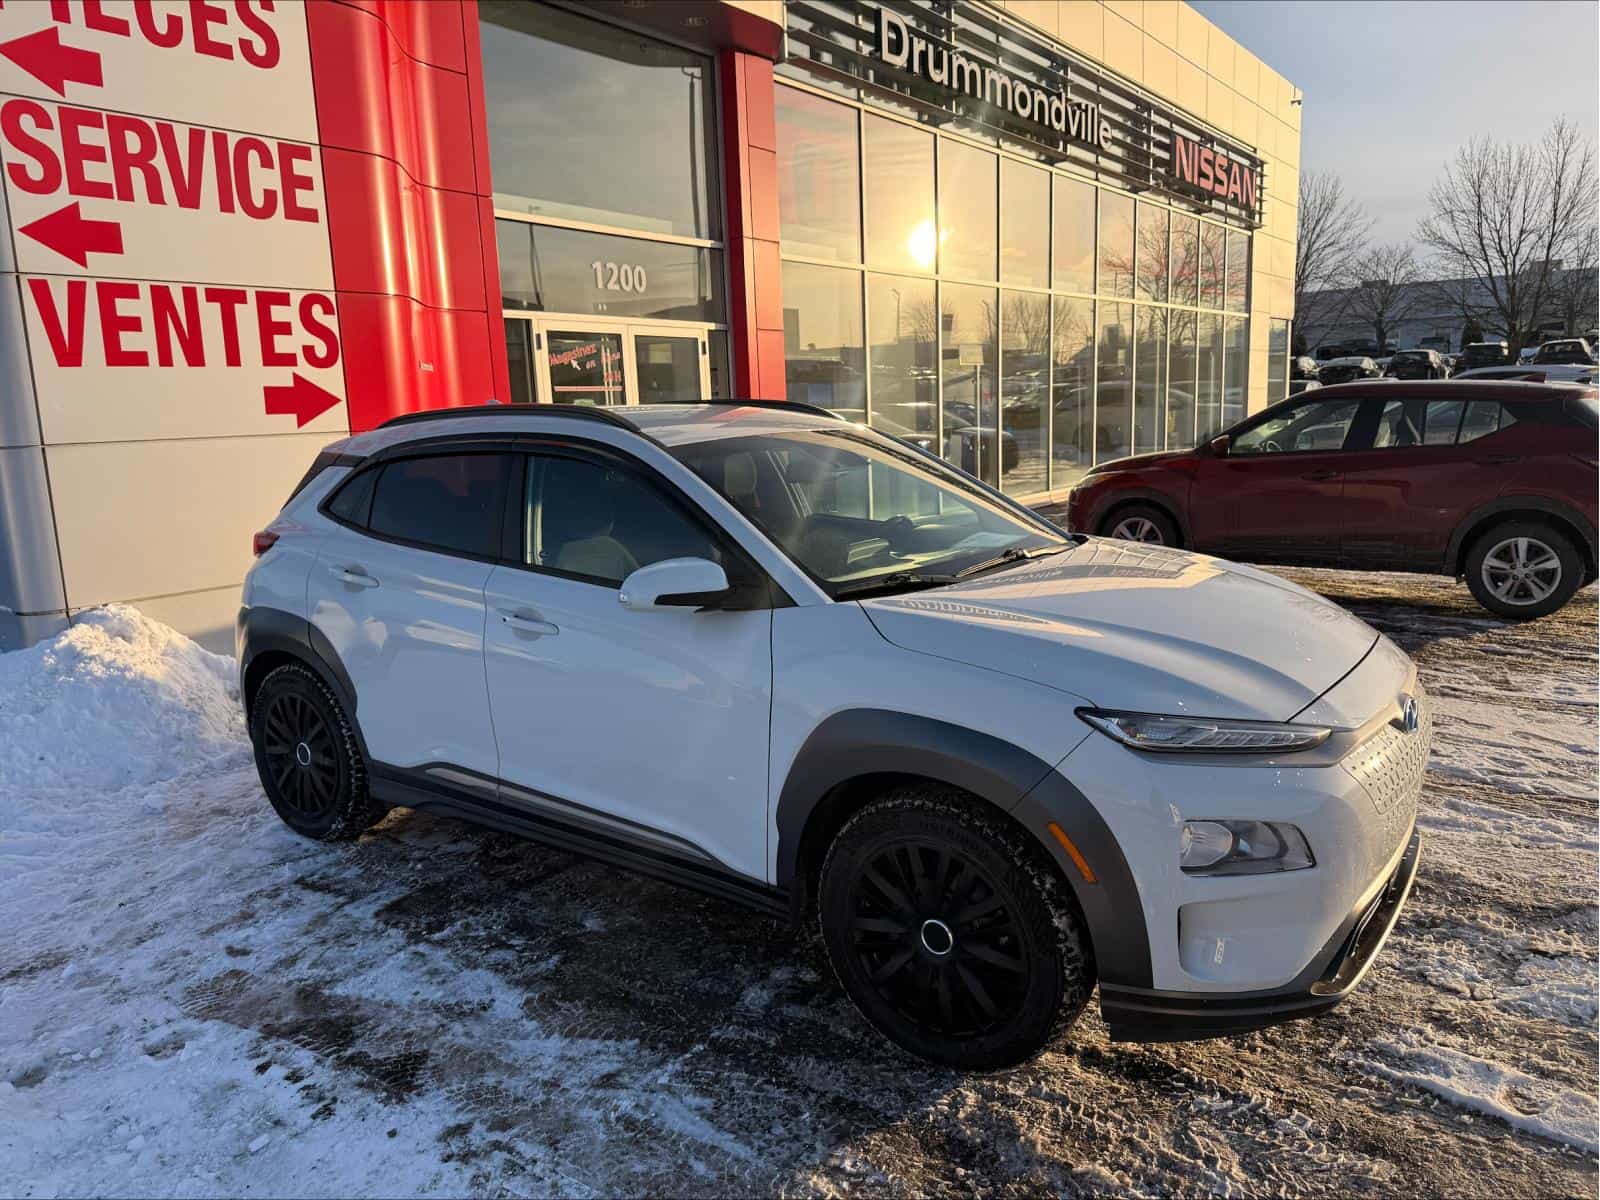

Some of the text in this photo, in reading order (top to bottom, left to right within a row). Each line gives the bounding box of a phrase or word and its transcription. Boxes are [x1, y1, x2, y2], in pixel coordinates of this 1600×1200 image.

[0, 0, 281, 69] CES
[881, 8, 1113, 150] Drummondville
[0, 99, 320, 223] SERVICE
[1175, 135, 1257, 209] NISSAN
[591, 261, 648, 293] 1200
[27, 278, 340, 369] VENTES
